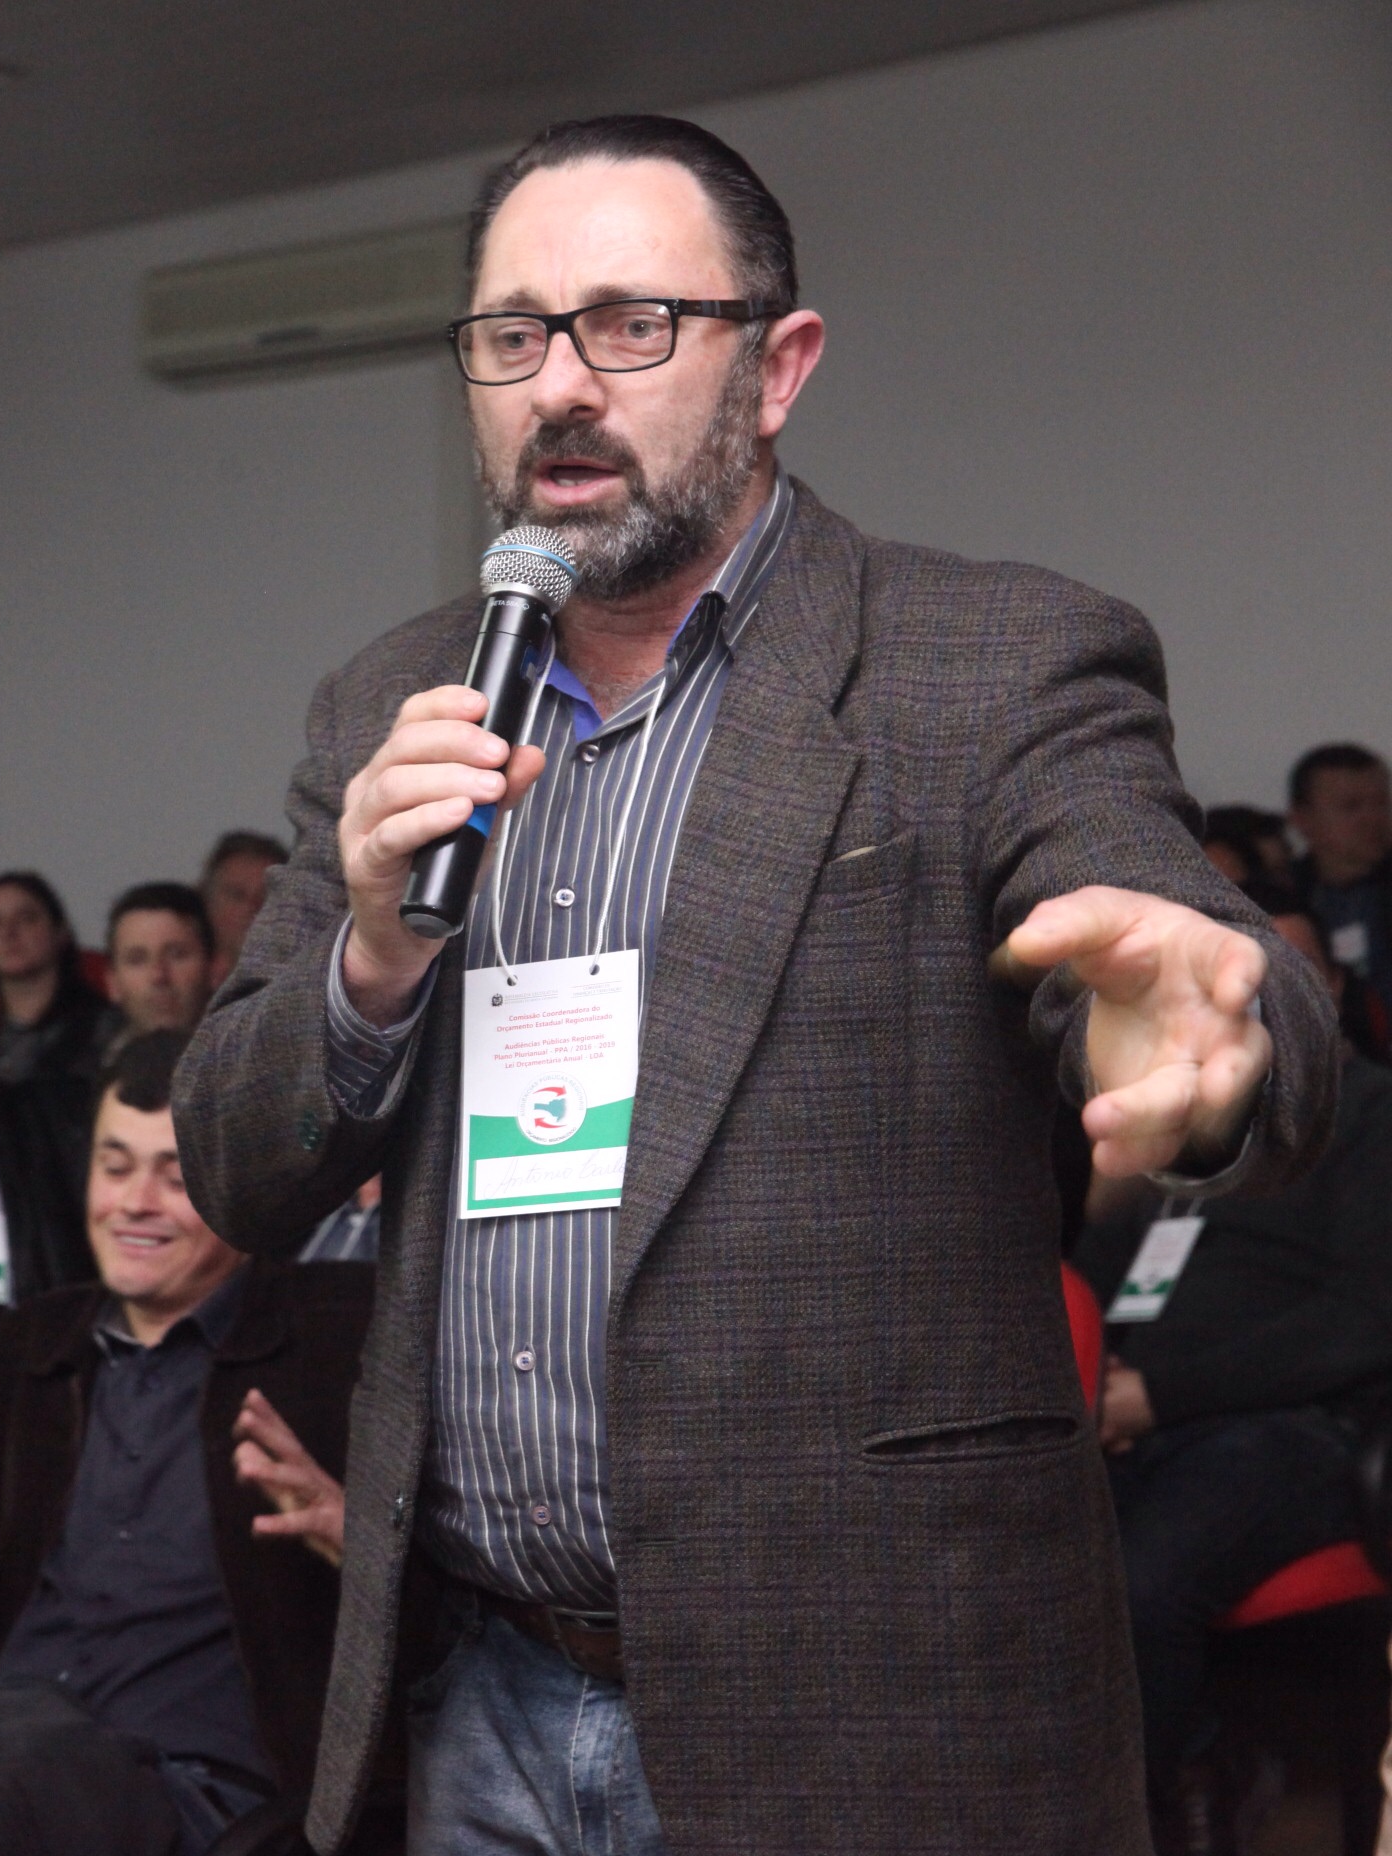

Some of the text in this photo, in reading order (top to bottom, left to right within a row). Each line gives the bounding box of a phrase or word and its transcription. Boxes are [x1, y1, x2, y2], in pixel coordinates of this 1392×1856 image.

[508, 1005, 601, 1022] Comissão Coordenadora do
[496, 1013, 613, 1032] Orçamento Estadual Regionalizado
[504, 1033, 605, 1050] Audiências Públicas Regionais
[494, 1052, 513, 1061] Plano
[514, 1049, 548, 1058] Plurianual
[575, 1044, 592, 1052] 2016
[516, 1057, 562, 1068] Orçamentária
[563, 1054, 583, 1062] Anual
[589, 1052, 604, 1060] LOA
